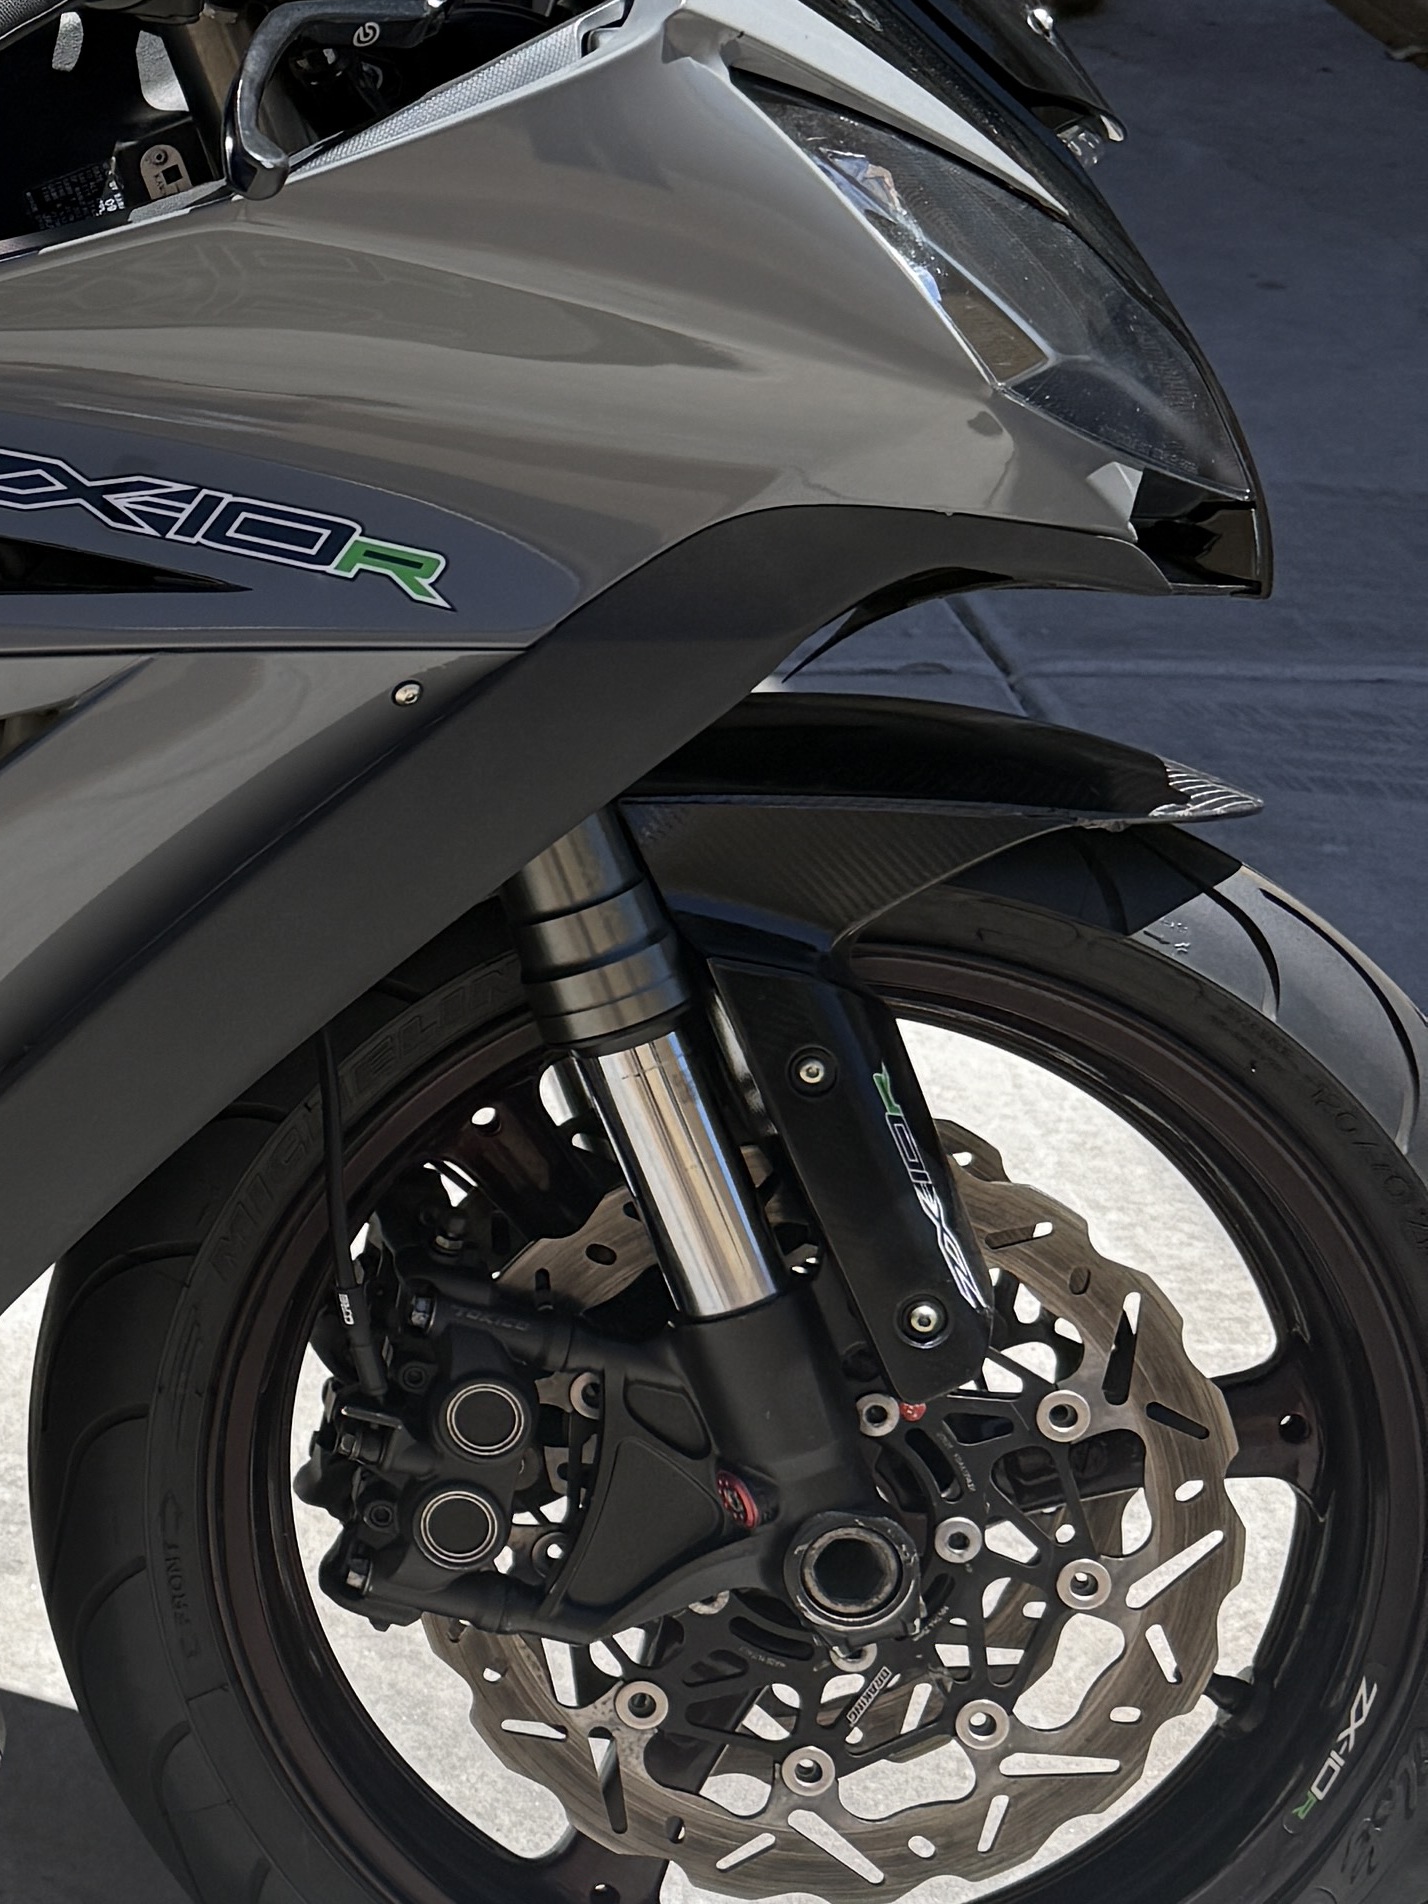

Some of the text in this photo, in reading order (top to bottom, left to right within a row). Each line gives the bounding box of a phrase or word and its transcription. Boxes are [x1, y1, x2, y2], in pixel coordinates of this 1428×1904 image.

[162, 1540, 191, 1625] FRONT
[847, 1666, 892, 1724] BRAKING
[1292, 1675, 1378, 1820] ZX-10R
